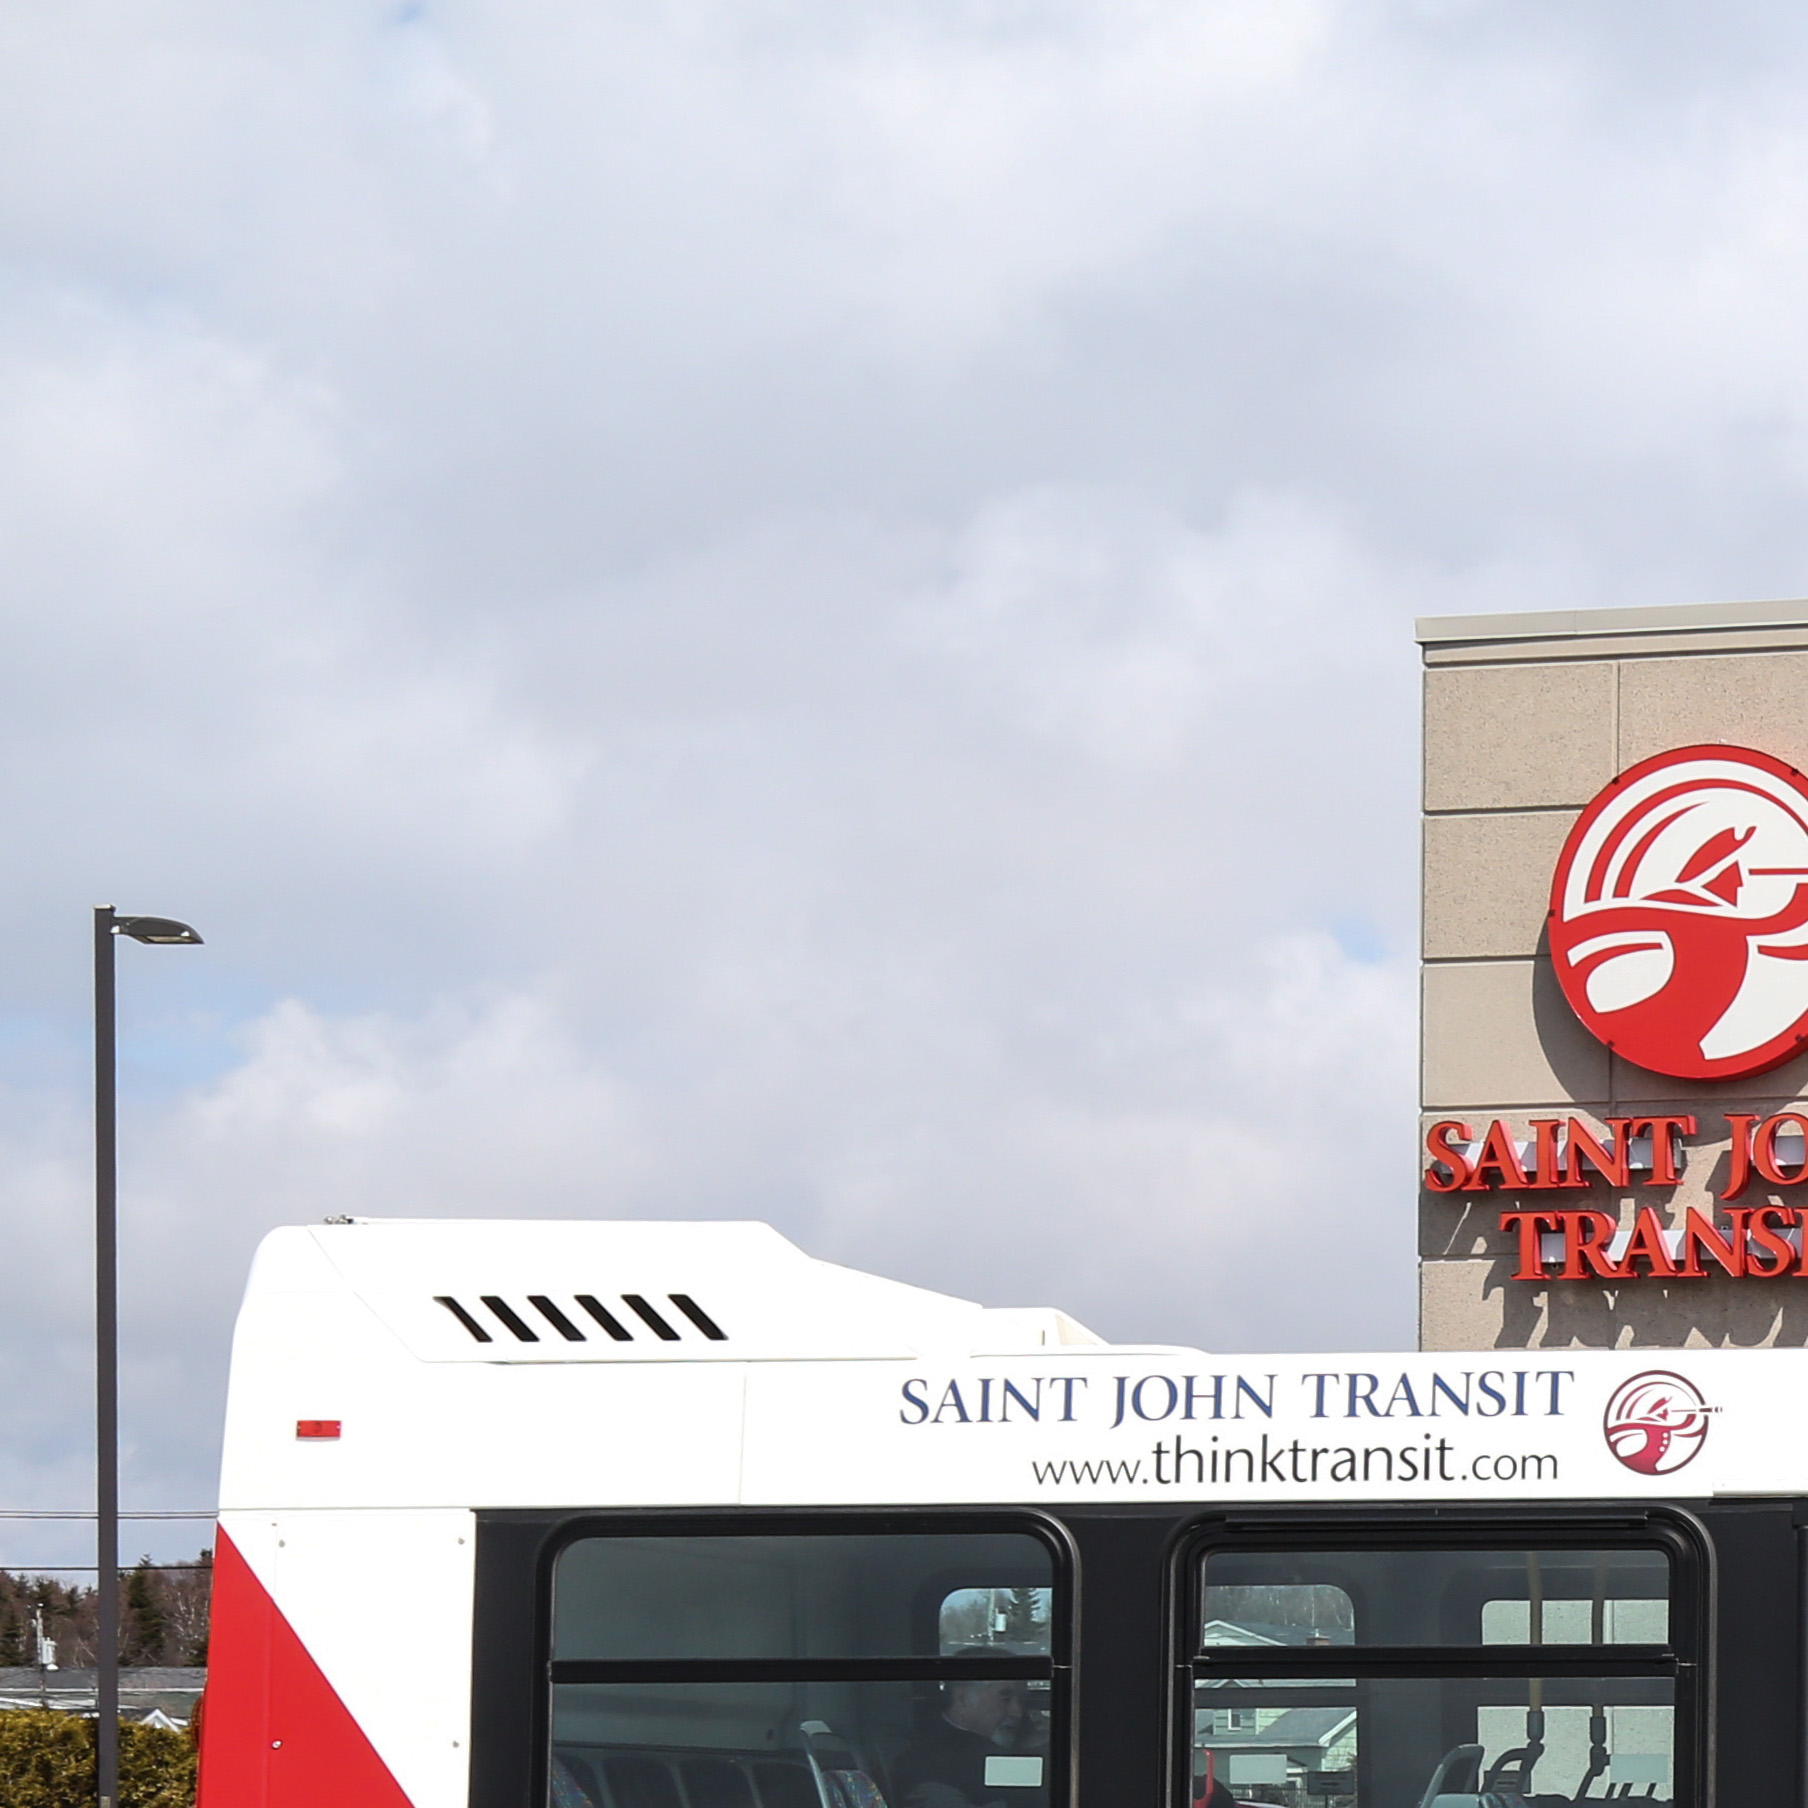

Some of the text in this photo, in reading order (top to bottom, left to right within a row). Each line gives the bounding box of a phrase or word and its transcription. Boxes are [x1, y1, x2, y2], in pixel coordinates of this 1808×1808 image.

[1425, 1114, 1697, 1193] SAINT
[899, 1370, 1576, 1429] SAINT JOHN TRANSIT
[1031, 1432, 1559, 1486] www.thinktransit.com
